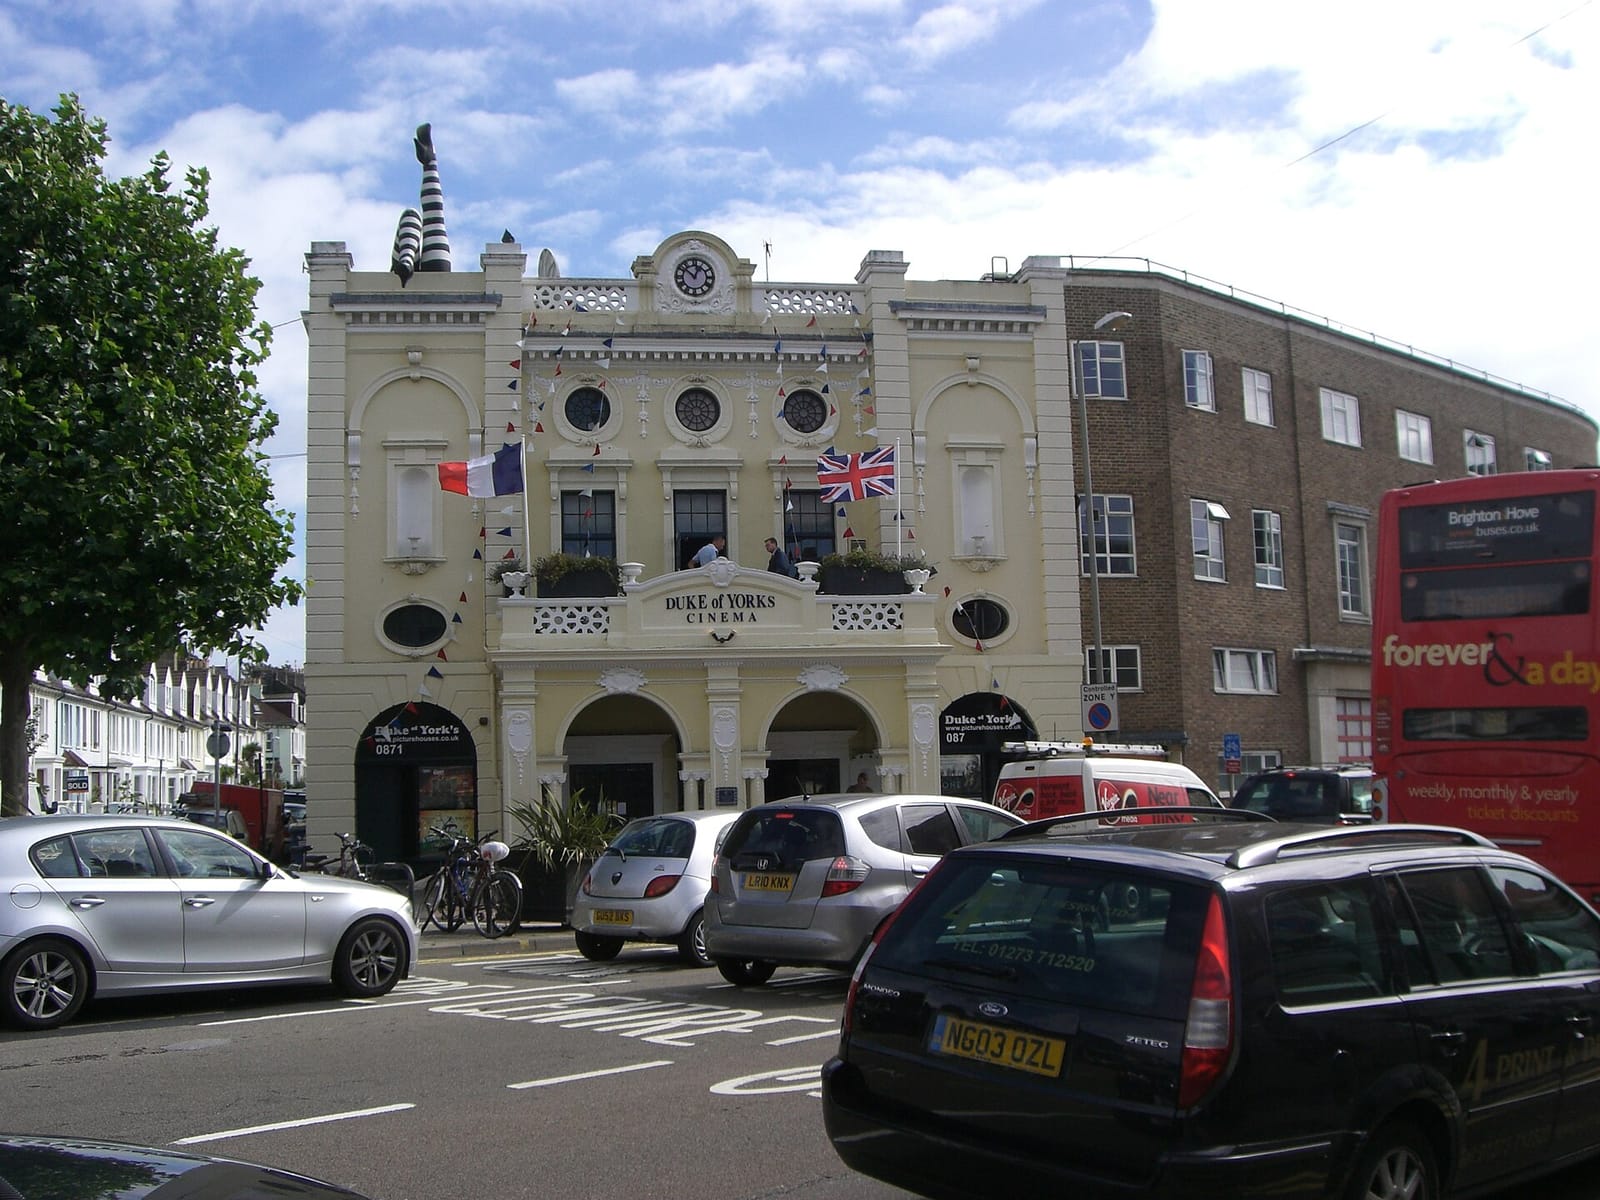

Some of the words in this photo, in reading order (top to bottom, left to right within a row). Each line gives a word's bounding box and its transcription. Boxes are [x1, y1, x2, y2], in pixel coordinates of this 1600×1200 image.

[1448, 509, 1502, 527] Brighton
[1506, 506, 1540, 520] Hove
[665, 594, 708, 610] DUKE
[711, 594, 725, 609] of
[727, 593, 776, 609] YORKS
[686, 611, 758, 624] CINEMA
[1382, 634, 1495, 667] forever
[1483, 631, 1529, 687] &
[1526, 661, 1545, 686] a
[1083, 693, 1106, 702] ZONE
[1110, 692, 1116, 701] Y
[944, 714, 977, 725] Duke
[420, 725, 460, 735] York's
[946, 733, 966, 743] 087
[376, 744, 403, 756] 0871
[67, 782, 88, 790] SOLD
[1146, 785, 1179, 808] Near
[1407, 783, 1457, 802] weekly,
[1460, 784, 1518, 804] monthly
[1521, 785, 1532, 801] &
[1535, 785, 1579, 805] yearly
[1467, 804, 1505, 820] ticket
[1510, 806, 1579, 823] discounts
[770, 875, 791, 889] KNX
[988, 943, 1034, 962] 01273
[1039, 949, 1097, 973] 712520
[945, 1021, 1008, 1059] NG03
[1010, 1032, 1057, 1071] OZL
[1125, 1035, 1170, 1049] ZETEC
